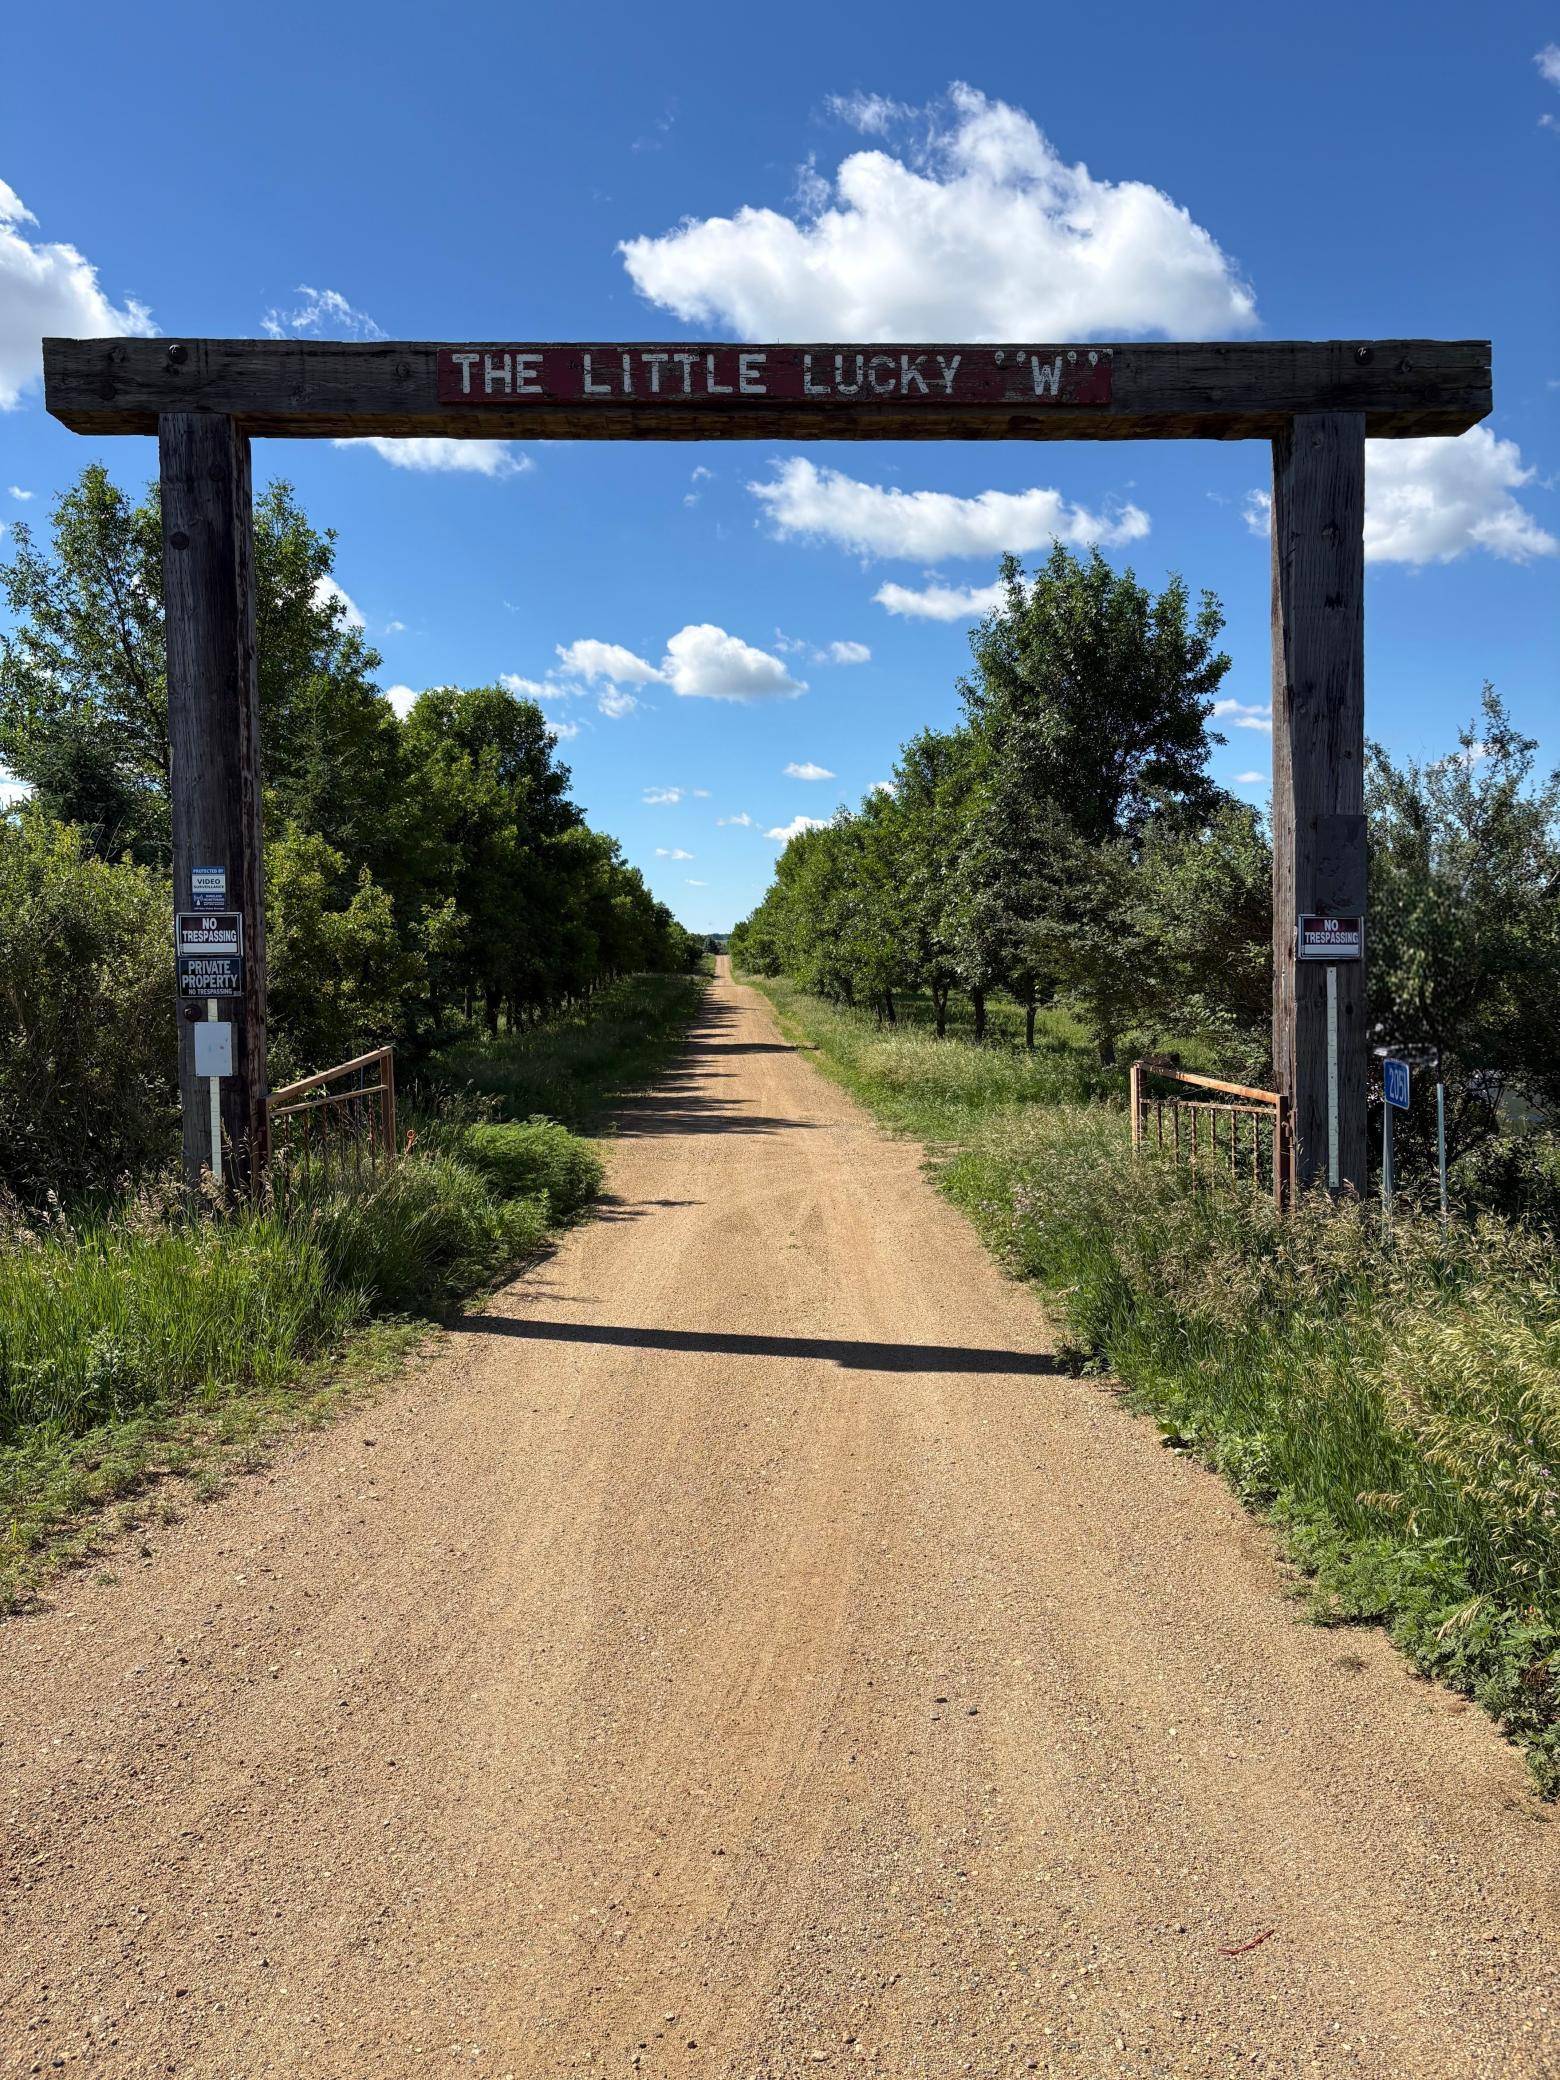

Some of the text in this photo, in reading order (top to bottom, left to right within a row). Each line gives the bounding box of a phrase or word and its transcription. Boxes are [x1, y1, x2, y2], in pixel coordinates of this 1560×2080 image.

[452, 353, 543, 394] THE
[583, 353, 767, 394] LITTLE
[803, 354, 961, 395] LUCKY
[202, 917, 218, 930] NO
[1324, 919, 1339, 931] NO
[182, 930, 237, 942] TRESPASSING
[1304, 931, 1359, 944] TRESPASSING
[188, 960, 231, 975] PRIVATE
[181, 974, 238, 988] PROPERTY
[1389, 1067, 1407, 1103] 2051
